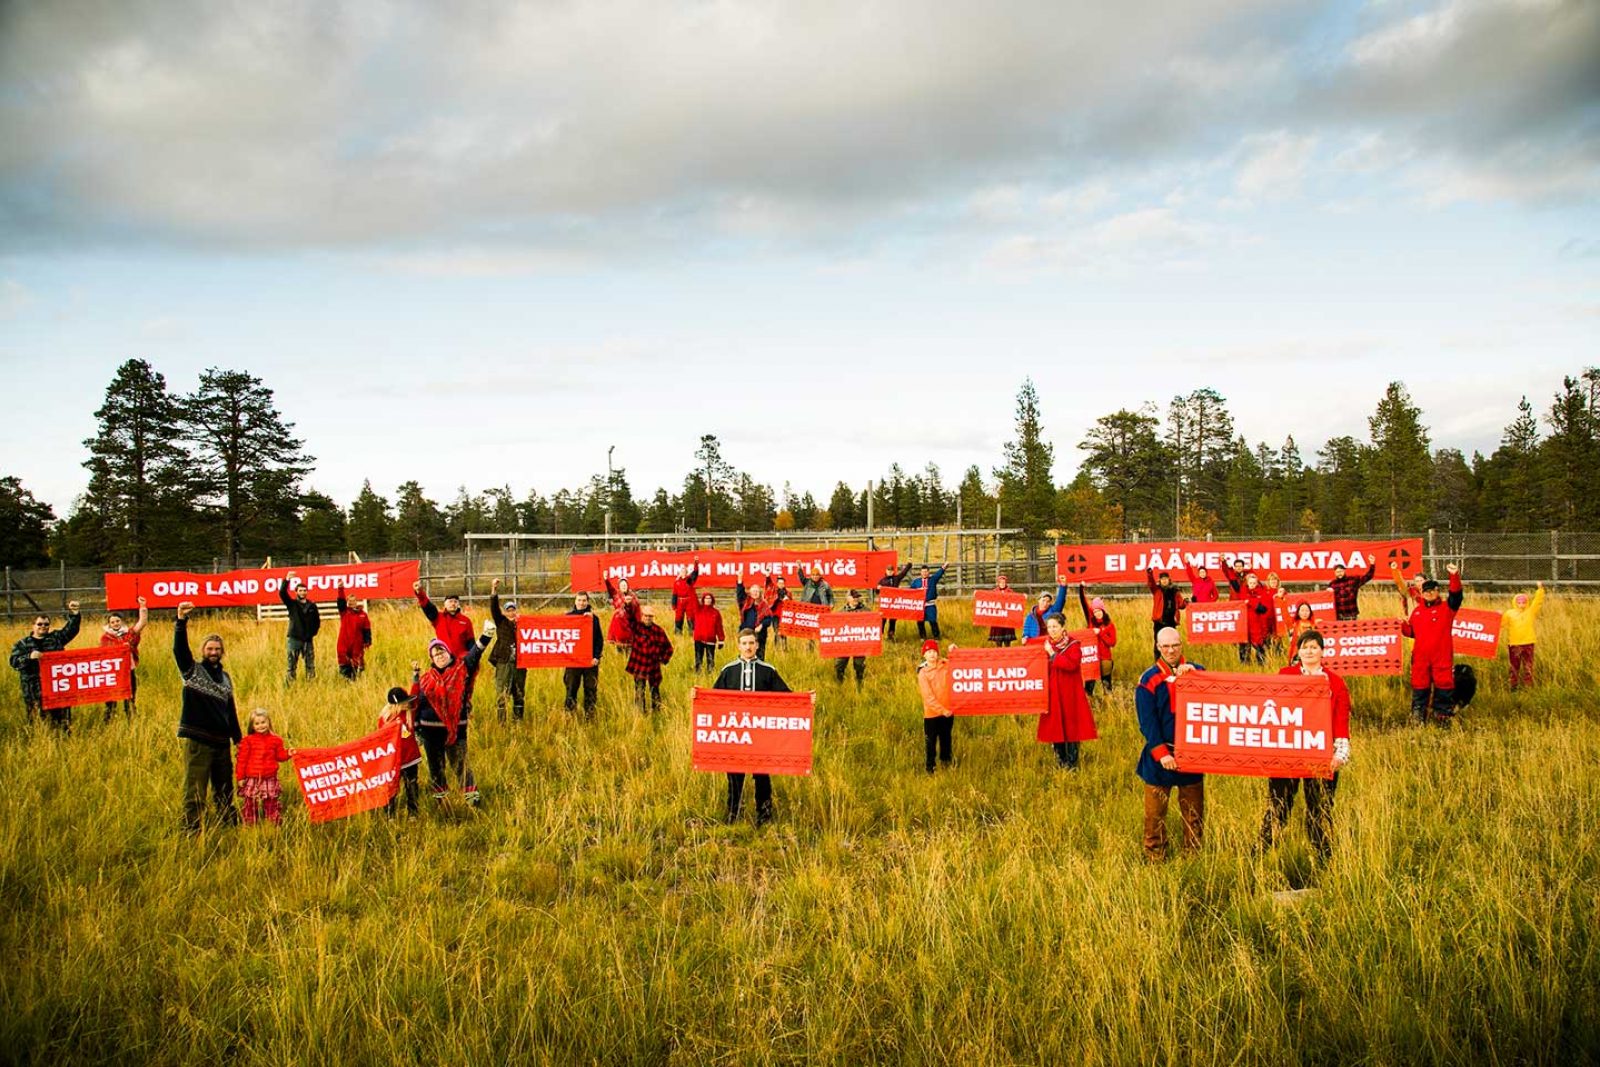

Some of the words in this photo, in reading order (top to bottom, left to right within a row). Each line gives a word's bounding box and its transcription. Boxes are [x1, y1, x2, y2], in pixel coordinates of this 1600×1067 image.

[1105, 554, 1126, 572] EI
[1280, 551, 1367, 570] RATAA
[609, 565, 636, 578] MIJ
[717, 562, 744, 576] MIJ
[153, 581, 199, 596] OUR
[206, 579, 259, 595] LAND
[307, 573, 379, 590] FUTURE
[1191, 610, 1241, 622] FOREST
[1192, 623, 1204, 633] IS
[1208, 621, 1236, 632] LIFE
[1452, 619, 1484, 631] LAND
[520, 629, 580, 641] VALITSE
[1339, 635, 1398, 646] CONSENT
[1451, 628, 1495, 643] FUTURE
[520, 640, 575, 654] METSÄT
[1339, 646, 1387, 657] ACCESS
[51, 658, 123, 678] FOREST
[952, 668, 983, 680] OUR
[987, 667, 1027, 679] LAND
[52, 678, 70, 692] IS
[77, 673, 117, 689] LIFE
[952, 681, 983, 692] OUR
[987, 679, 1043, 692] FUTURE
[1186, 699, 1303, 726] EENNÂM
[696, 714, 712, 727] EI
[717, 711, 811, 731] JÄÄMEREN
[696, 729, 753, 744] RATAA
[1185, 724, 1218, 745] LII
[1228, 726, 1326, 750] EELLIM
[300, 755, 358, 779] MEIDÄN
[361, 742, 396, 763] MAA
[303, 767, 362, 792] MEIDÄN
